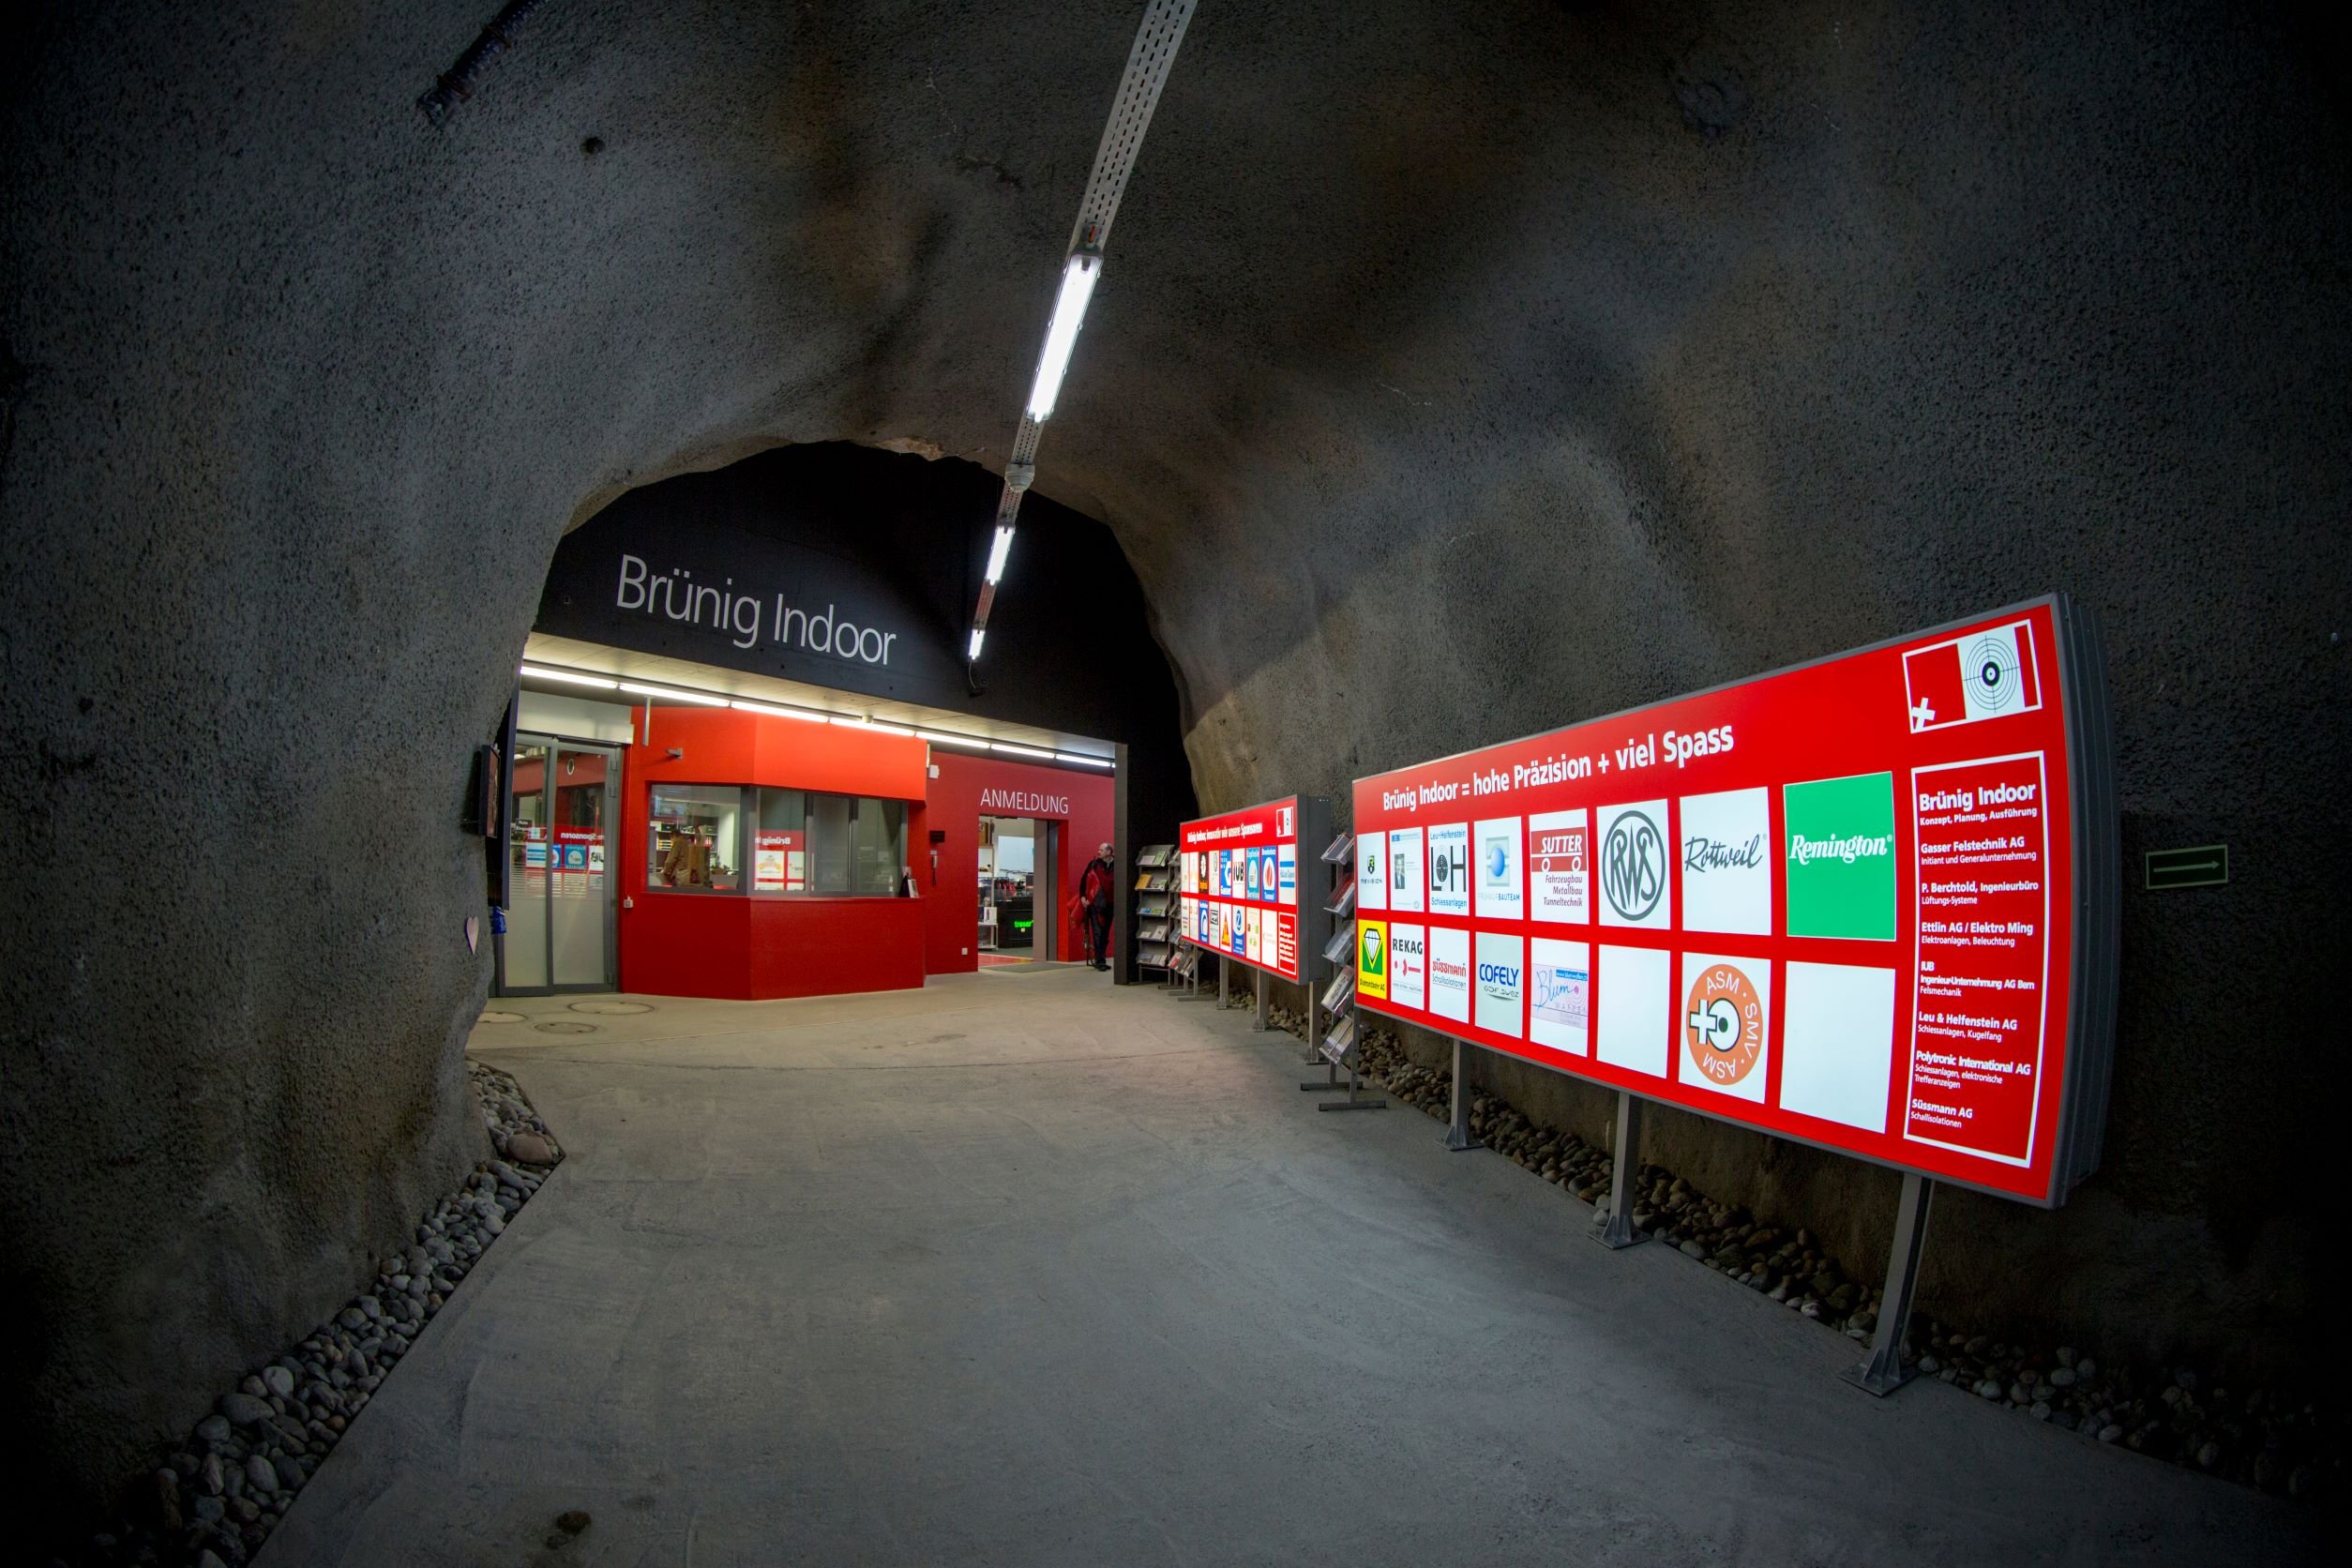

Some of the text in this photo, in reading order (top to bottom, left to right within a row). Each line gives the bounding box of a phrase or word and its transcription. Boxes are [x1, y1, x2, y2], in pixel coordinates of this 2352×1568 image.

[617, 554, 897, 666] Brünig Indoor
[1383, 787, 1417, 812] Brünig
[1419, 779, 1458, 805] Indoor
[1473, 771, 1510, 795] hohe
[1514, 753, 1591, 790] Präzision
[1616, 733, 1655, 772] viel
[1663, 725, 1734, 769] Spass
[980, 788, 1069, 814] ANMELDUNG
[1920, 782, 2036, 812] Brünig Indoor
[1920, 807, 2037, 826] Konzept, Planung, Ausführung
[1541, 835, 1582, 854] SUTTER
[1921, 836, 2025, 854] Gasser Felstechnik AG
[1609, 820, 1657, 911] RWS
[1921, 850, 2037, 865] Initiant und Generalunternehmung
[1545, 875, 1583, 885] Fahrzeugbau
[1922, 881, 2039, 894] P. Berchtold, Ingenieurbüro
[1553, 886, 1583, 896] Metallbau
[1544, 897, 1583, 907] Tunneltechnik
[1922, 894, 1978, 907] Lüftungs-Systeme
[1922, 922, 1945, 933] Ettlin
[1947, 922, 1963, 933] AG
[1970, 922, 2005, 934] Elektro
[2007, 923, 2034, 936] Ming
[1392, 938, 1424, 956] REKAG
[1922, 935, 2015, 948] Elektroanlagen, Beleuchtung
[1479, 963, 1519, 988] COFELY
[1921, 961, 1935, 972] IUB
[1535, 969, 1571, 1007] Blum
[1921, 974, 2035, 990] Ingenieur-Unternehmung AG Bern
[1920, 987, 1962, 998] Felsmechanik
[1702, 971, 1759, 1078] ASM SMV ASM
[1919, 1011, 2018, 1031] Leu & Helfenstein AG
[1918, 1024, 2002, 1044] Schiessanlagen, Kugelfang
[1916, 1050, 2031, 1076] Polytronic International AG
[1914, 1074, 1961, 1090] Trefferanzeigen
[1915, 1063, 2003, 1085] Schiessanlagen, elektronische
[1912, 1098, 1973, 1120] Süssmann AG
[1910, 1111, 1962, 1129] Schallisolationen
